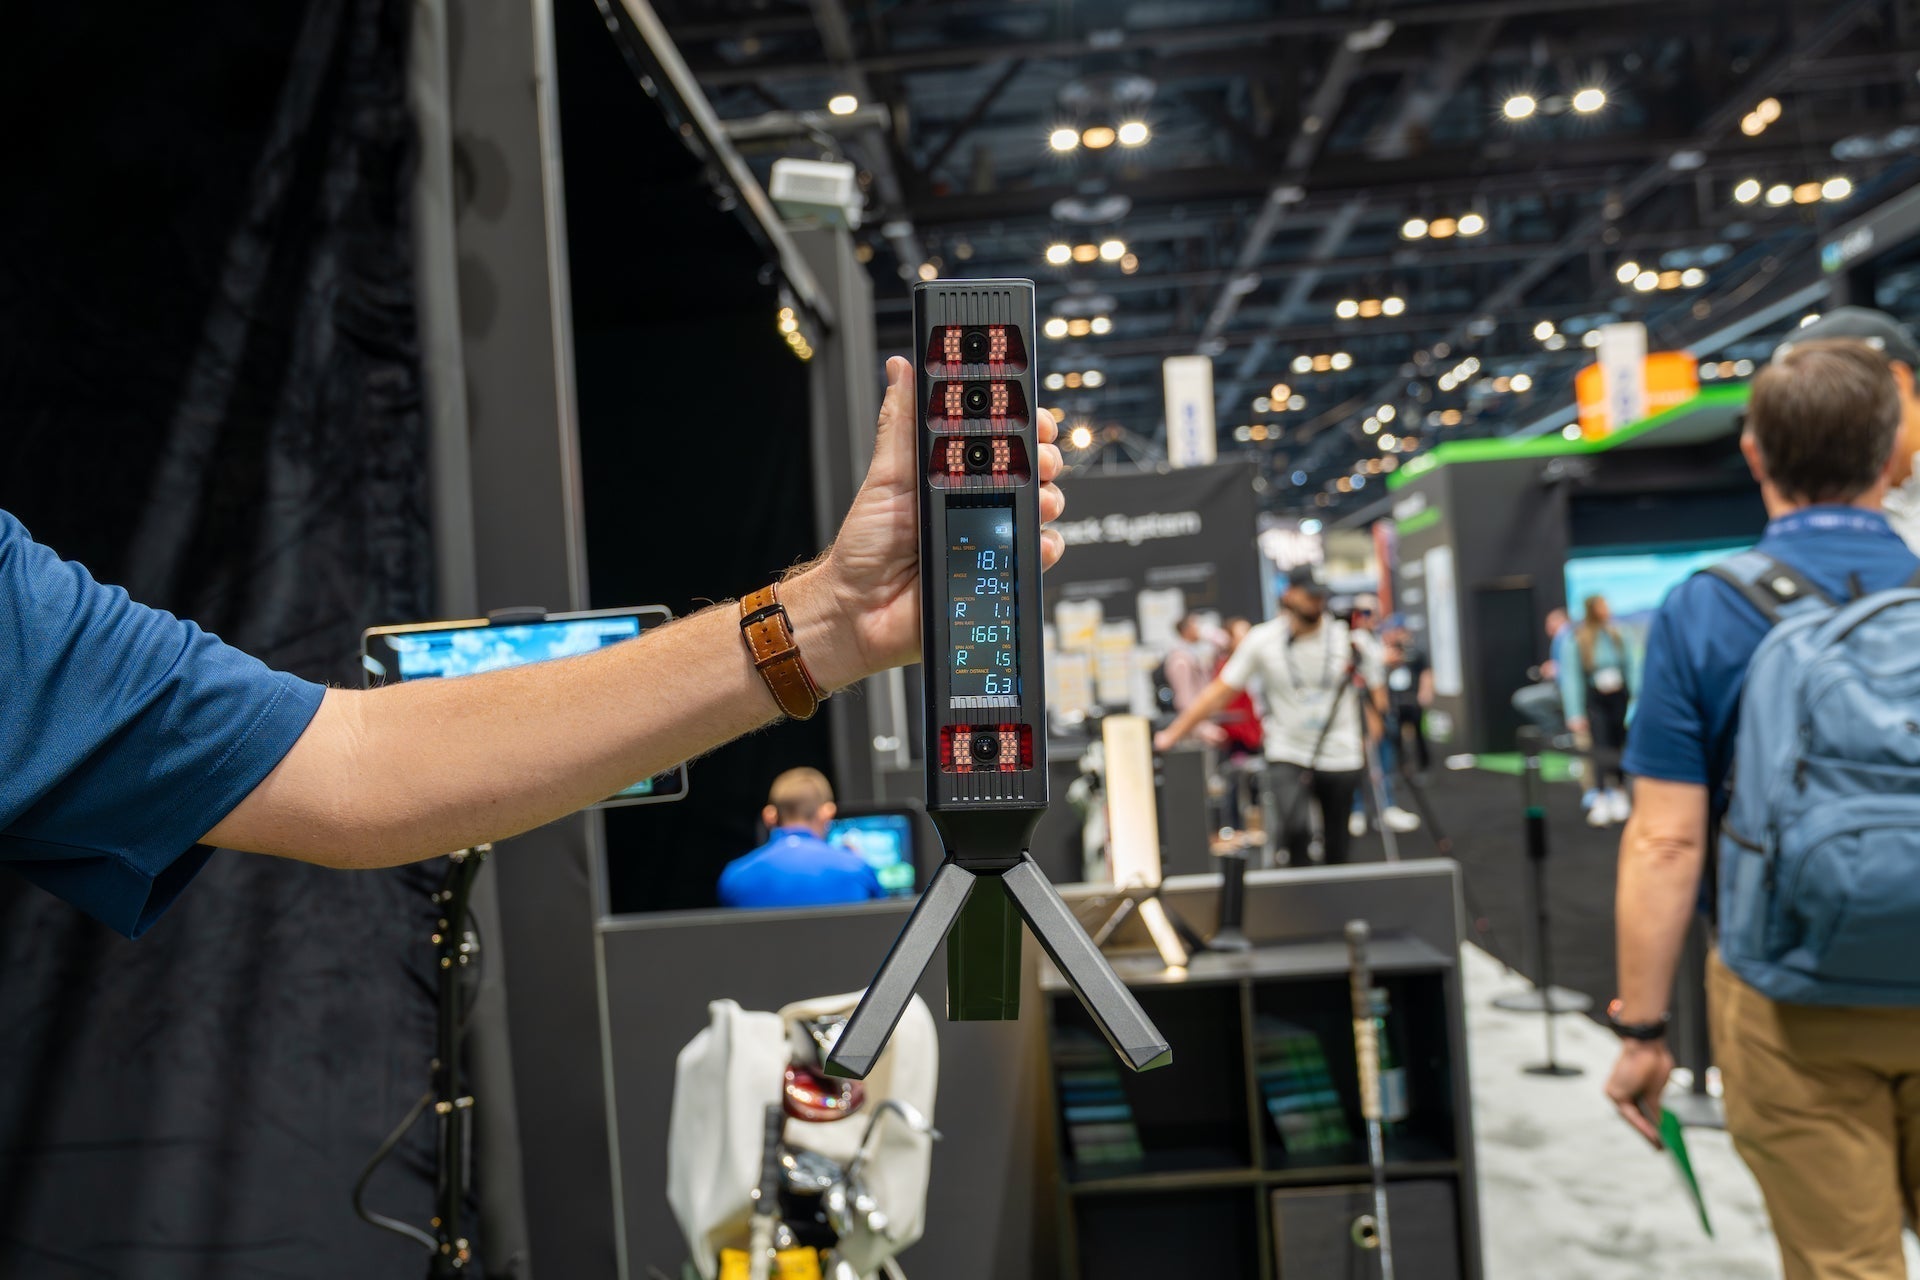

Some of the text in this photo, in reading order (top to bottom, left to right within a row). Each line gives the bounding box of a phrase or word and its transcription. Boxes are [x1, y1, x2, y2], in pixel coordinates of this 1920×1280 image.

[977, 550, 1009, 570] 18.1
[975, 577, 1009, 595] 29.4
[955, 602, 1010, 618] R 1.1
[971, 625, 1010, 643] 1667
[956, 650, 1011, 667] R 1.5
[985, 673, 1012, 694] 6.3
